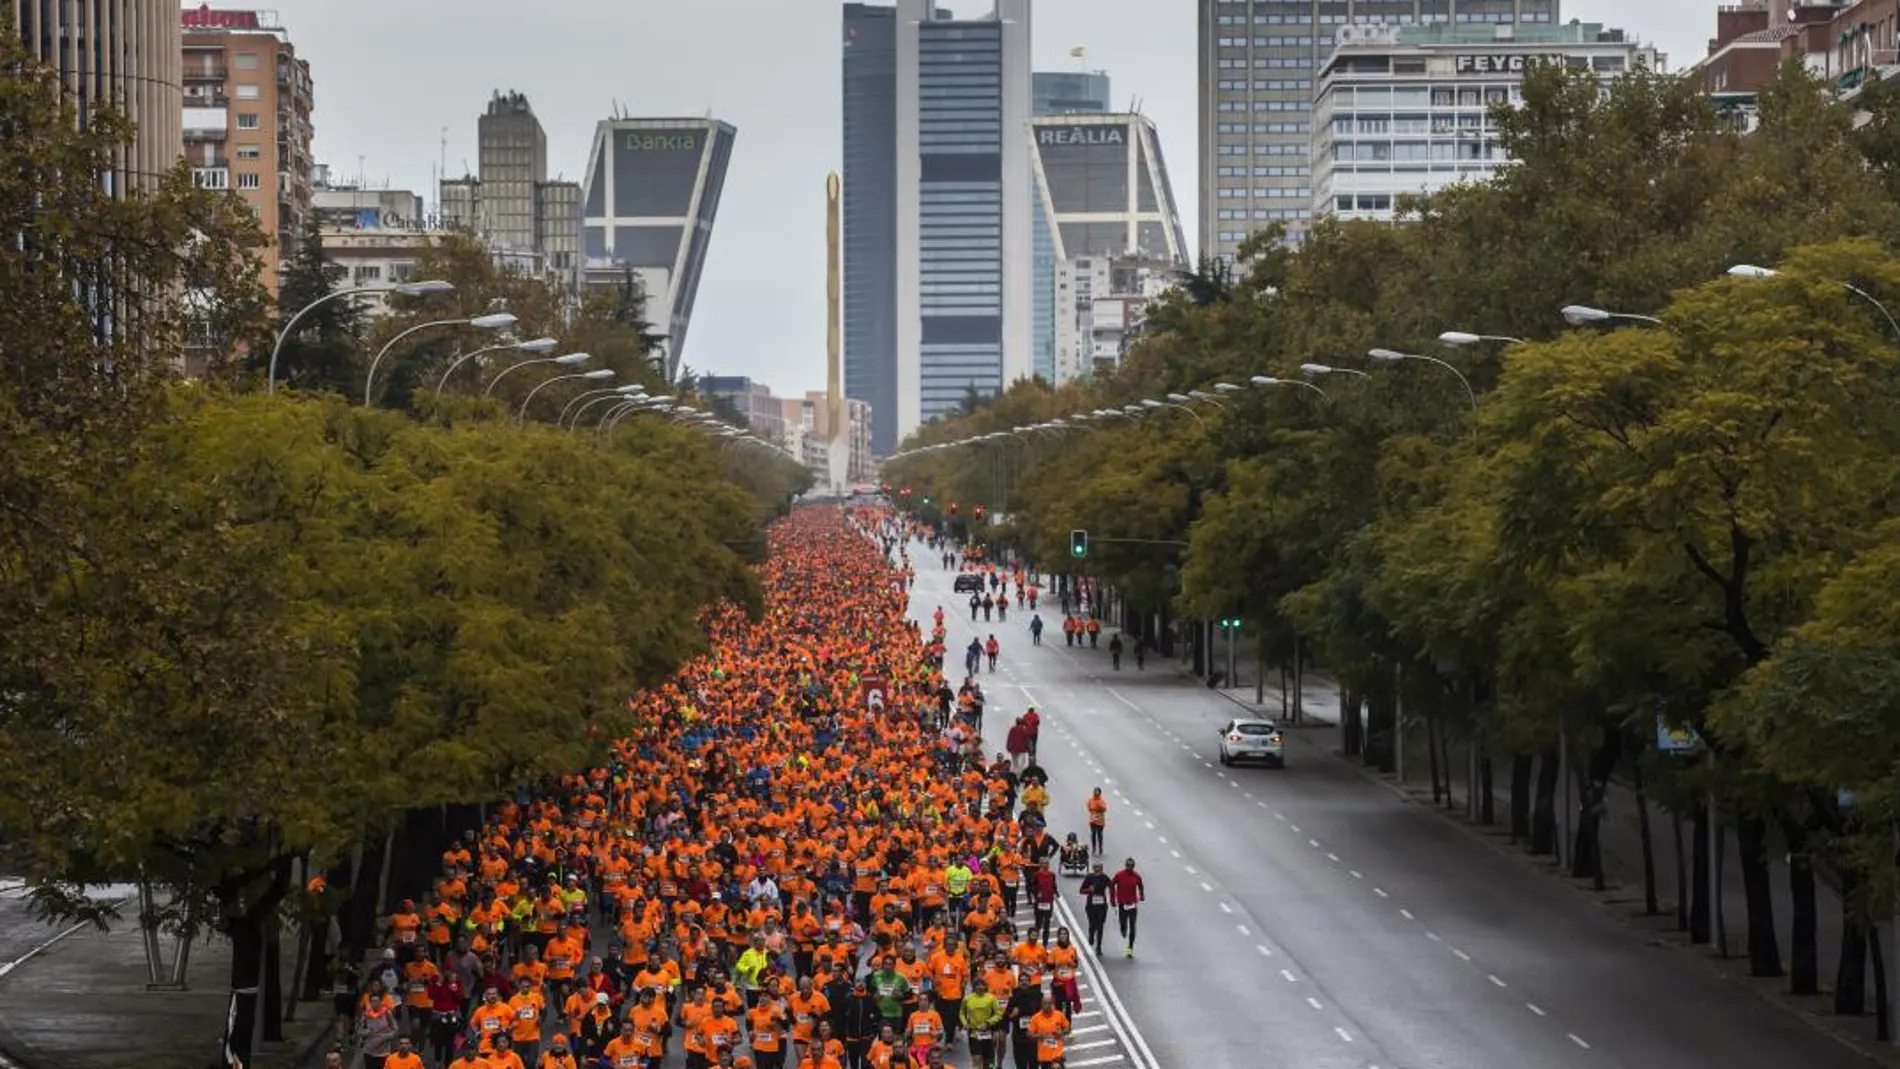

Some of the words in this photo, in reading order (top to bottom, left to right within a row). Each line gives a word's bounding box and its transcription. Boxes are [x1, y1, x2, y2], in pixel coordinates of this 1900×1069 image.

[626, 133, 695, 150] Bankia
[1040, 127, 1123, 144] REALIA
[868, 688, 885, 711] 6
